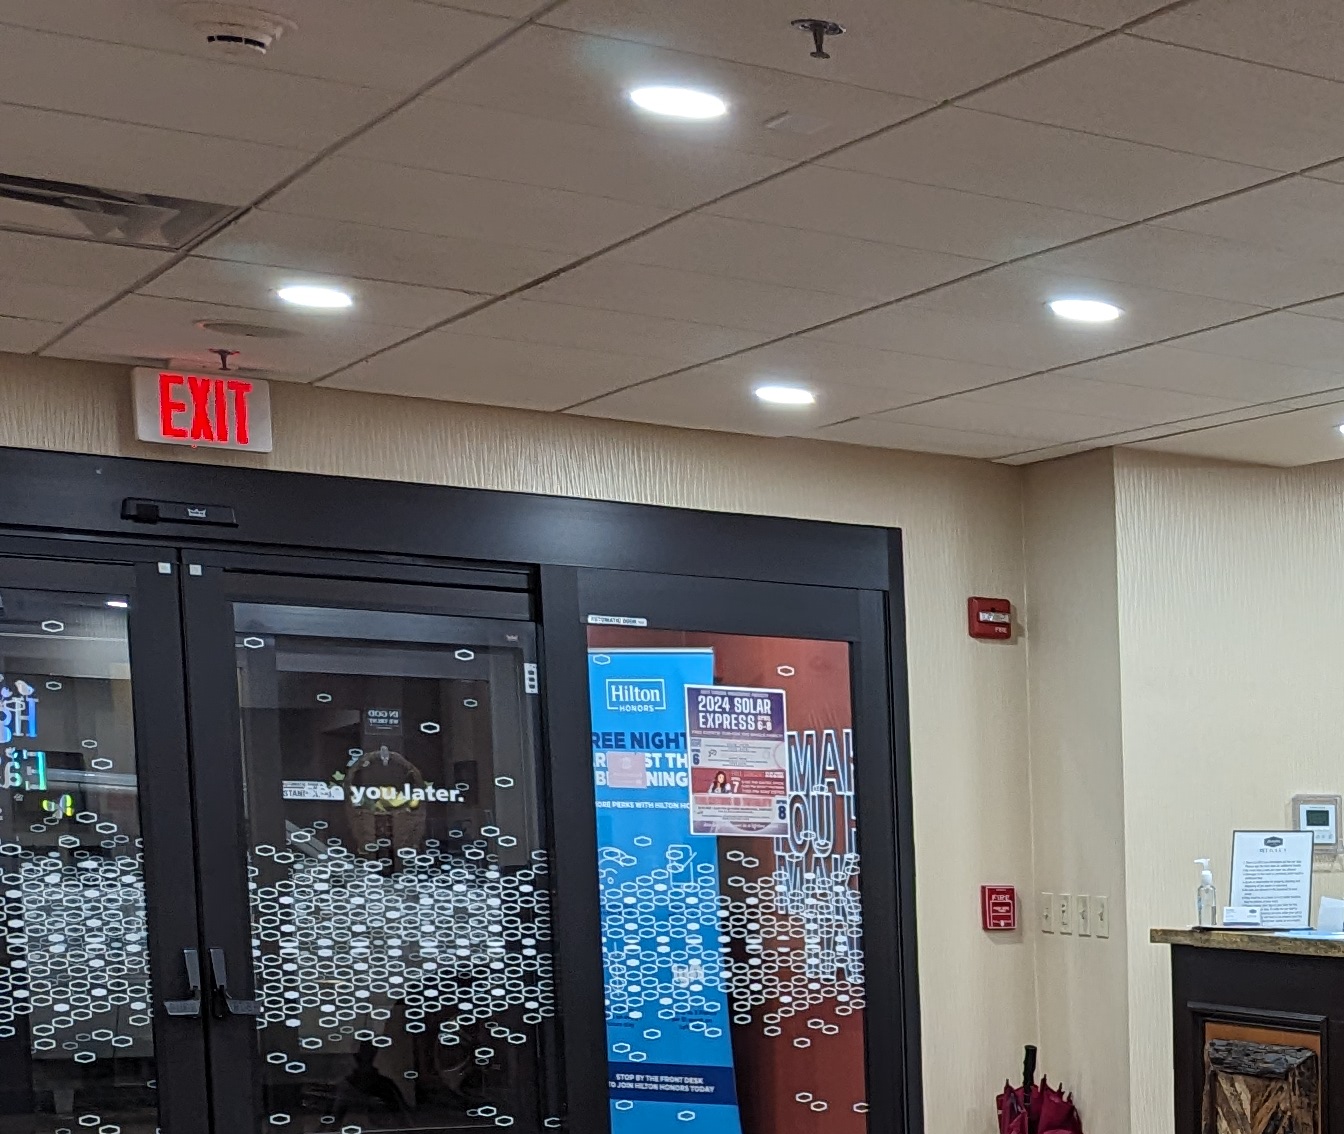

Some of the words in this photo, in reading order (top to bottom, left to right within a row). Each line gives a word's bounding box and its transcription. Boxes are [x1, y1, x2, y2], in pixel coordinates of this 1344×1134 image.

[159, 373, 252, 445] EXIT
[611, 685, 660, 701] Hilton
[698, 695, 730, 712] 2024
[734, 697, 771, 714] SOLAR
[699, 712, 755, 730] EXPRESS
[592, 732, 625, 749] REE
[630, 732, 687, 749] NIGHT
[665, 753, 688, 768] TH
[351, 784, 397, 804] you
[403, 783, 464, 802] later.
[732, 781, 740, 793] 7
[778, 805, 786, 820] 8
